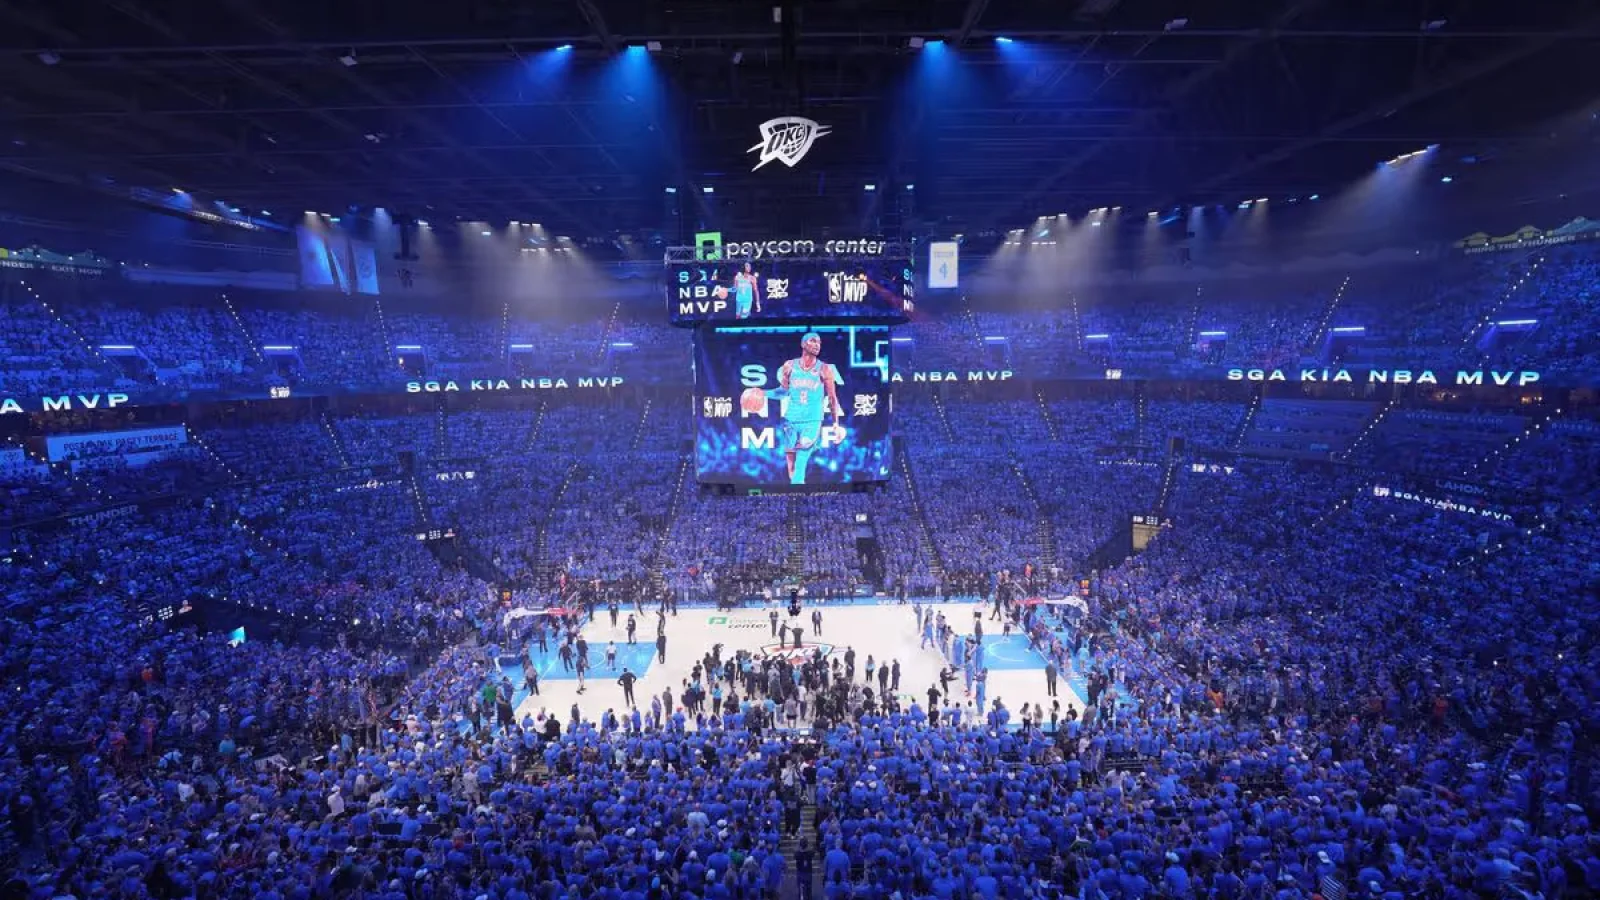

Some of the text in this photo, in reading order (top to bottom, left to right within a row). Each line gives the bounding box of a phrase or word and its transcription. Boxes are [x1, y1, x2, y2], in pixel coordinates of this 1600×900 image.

[726, 238, 886, 259] paycom center
[843, 281, 868, 302] MVP
[680, 300, 728, 315] MVP
[406, 377, 624, 393] SGA KIA NBA MVP
[914, 371, 958, 382] NBA
[968, 370, 1013, 382] MVP
[1227, 368, 1541, 386] SGA KIA NBA MVP
[42, 393, 129, 411] MVP
